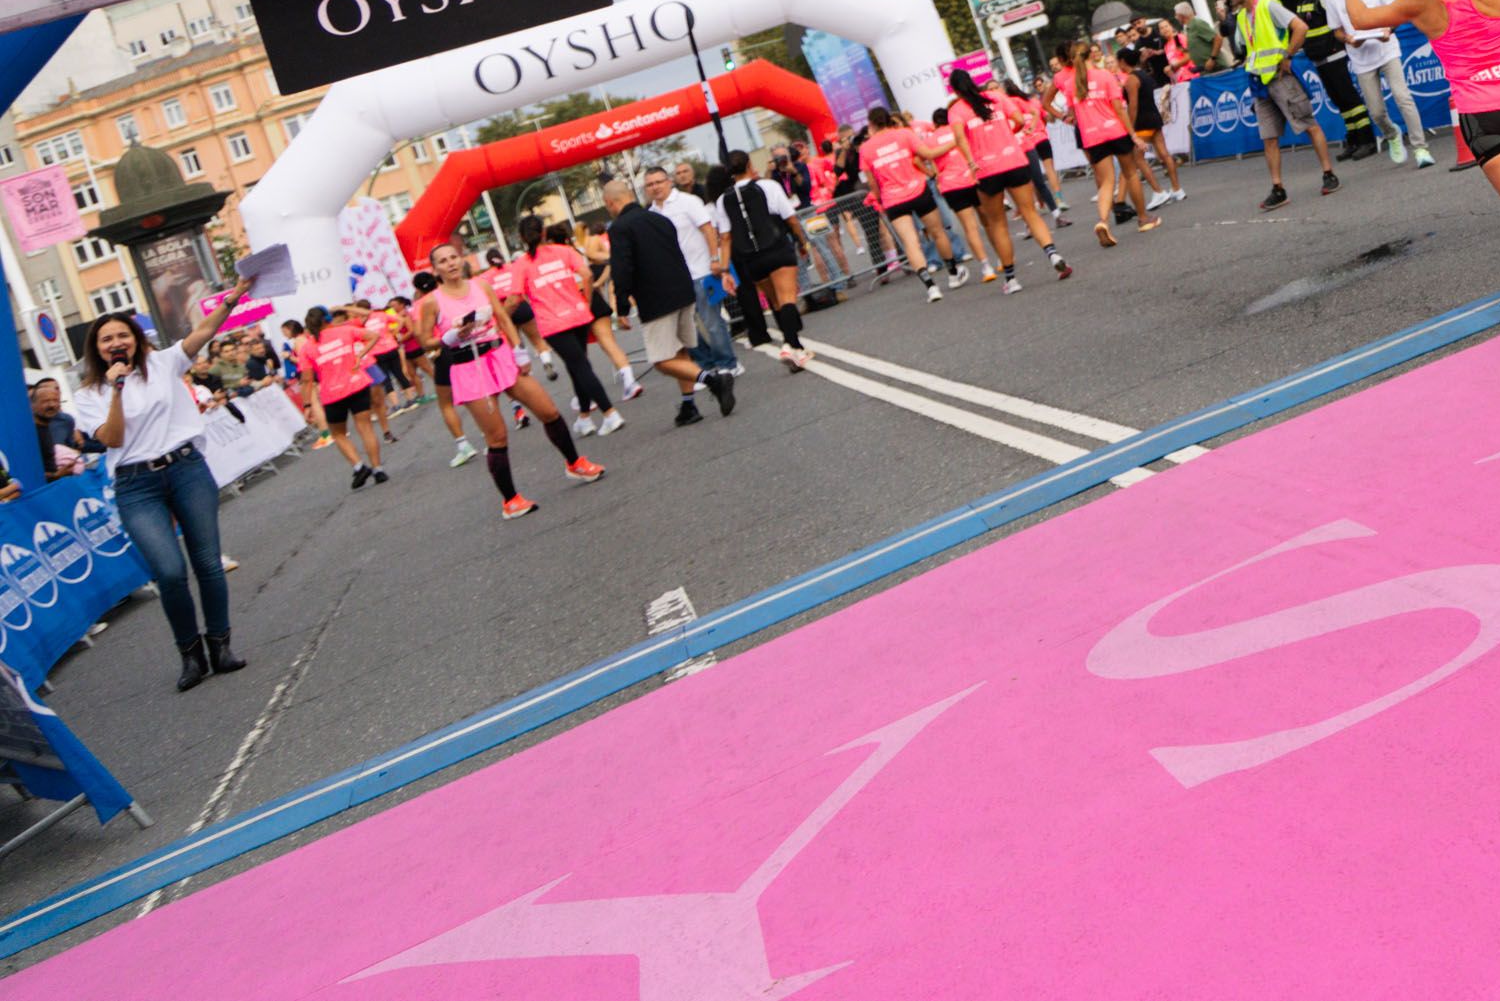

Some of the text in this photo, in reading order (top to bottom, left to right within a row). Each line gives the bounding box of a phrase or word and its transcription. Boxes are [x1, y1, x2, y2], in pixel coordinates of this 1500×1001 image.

[473, 0, 697, 96] OYSHO
[550, 131, 595, 153] Sports
[612, 104, 680, 134] Santander
